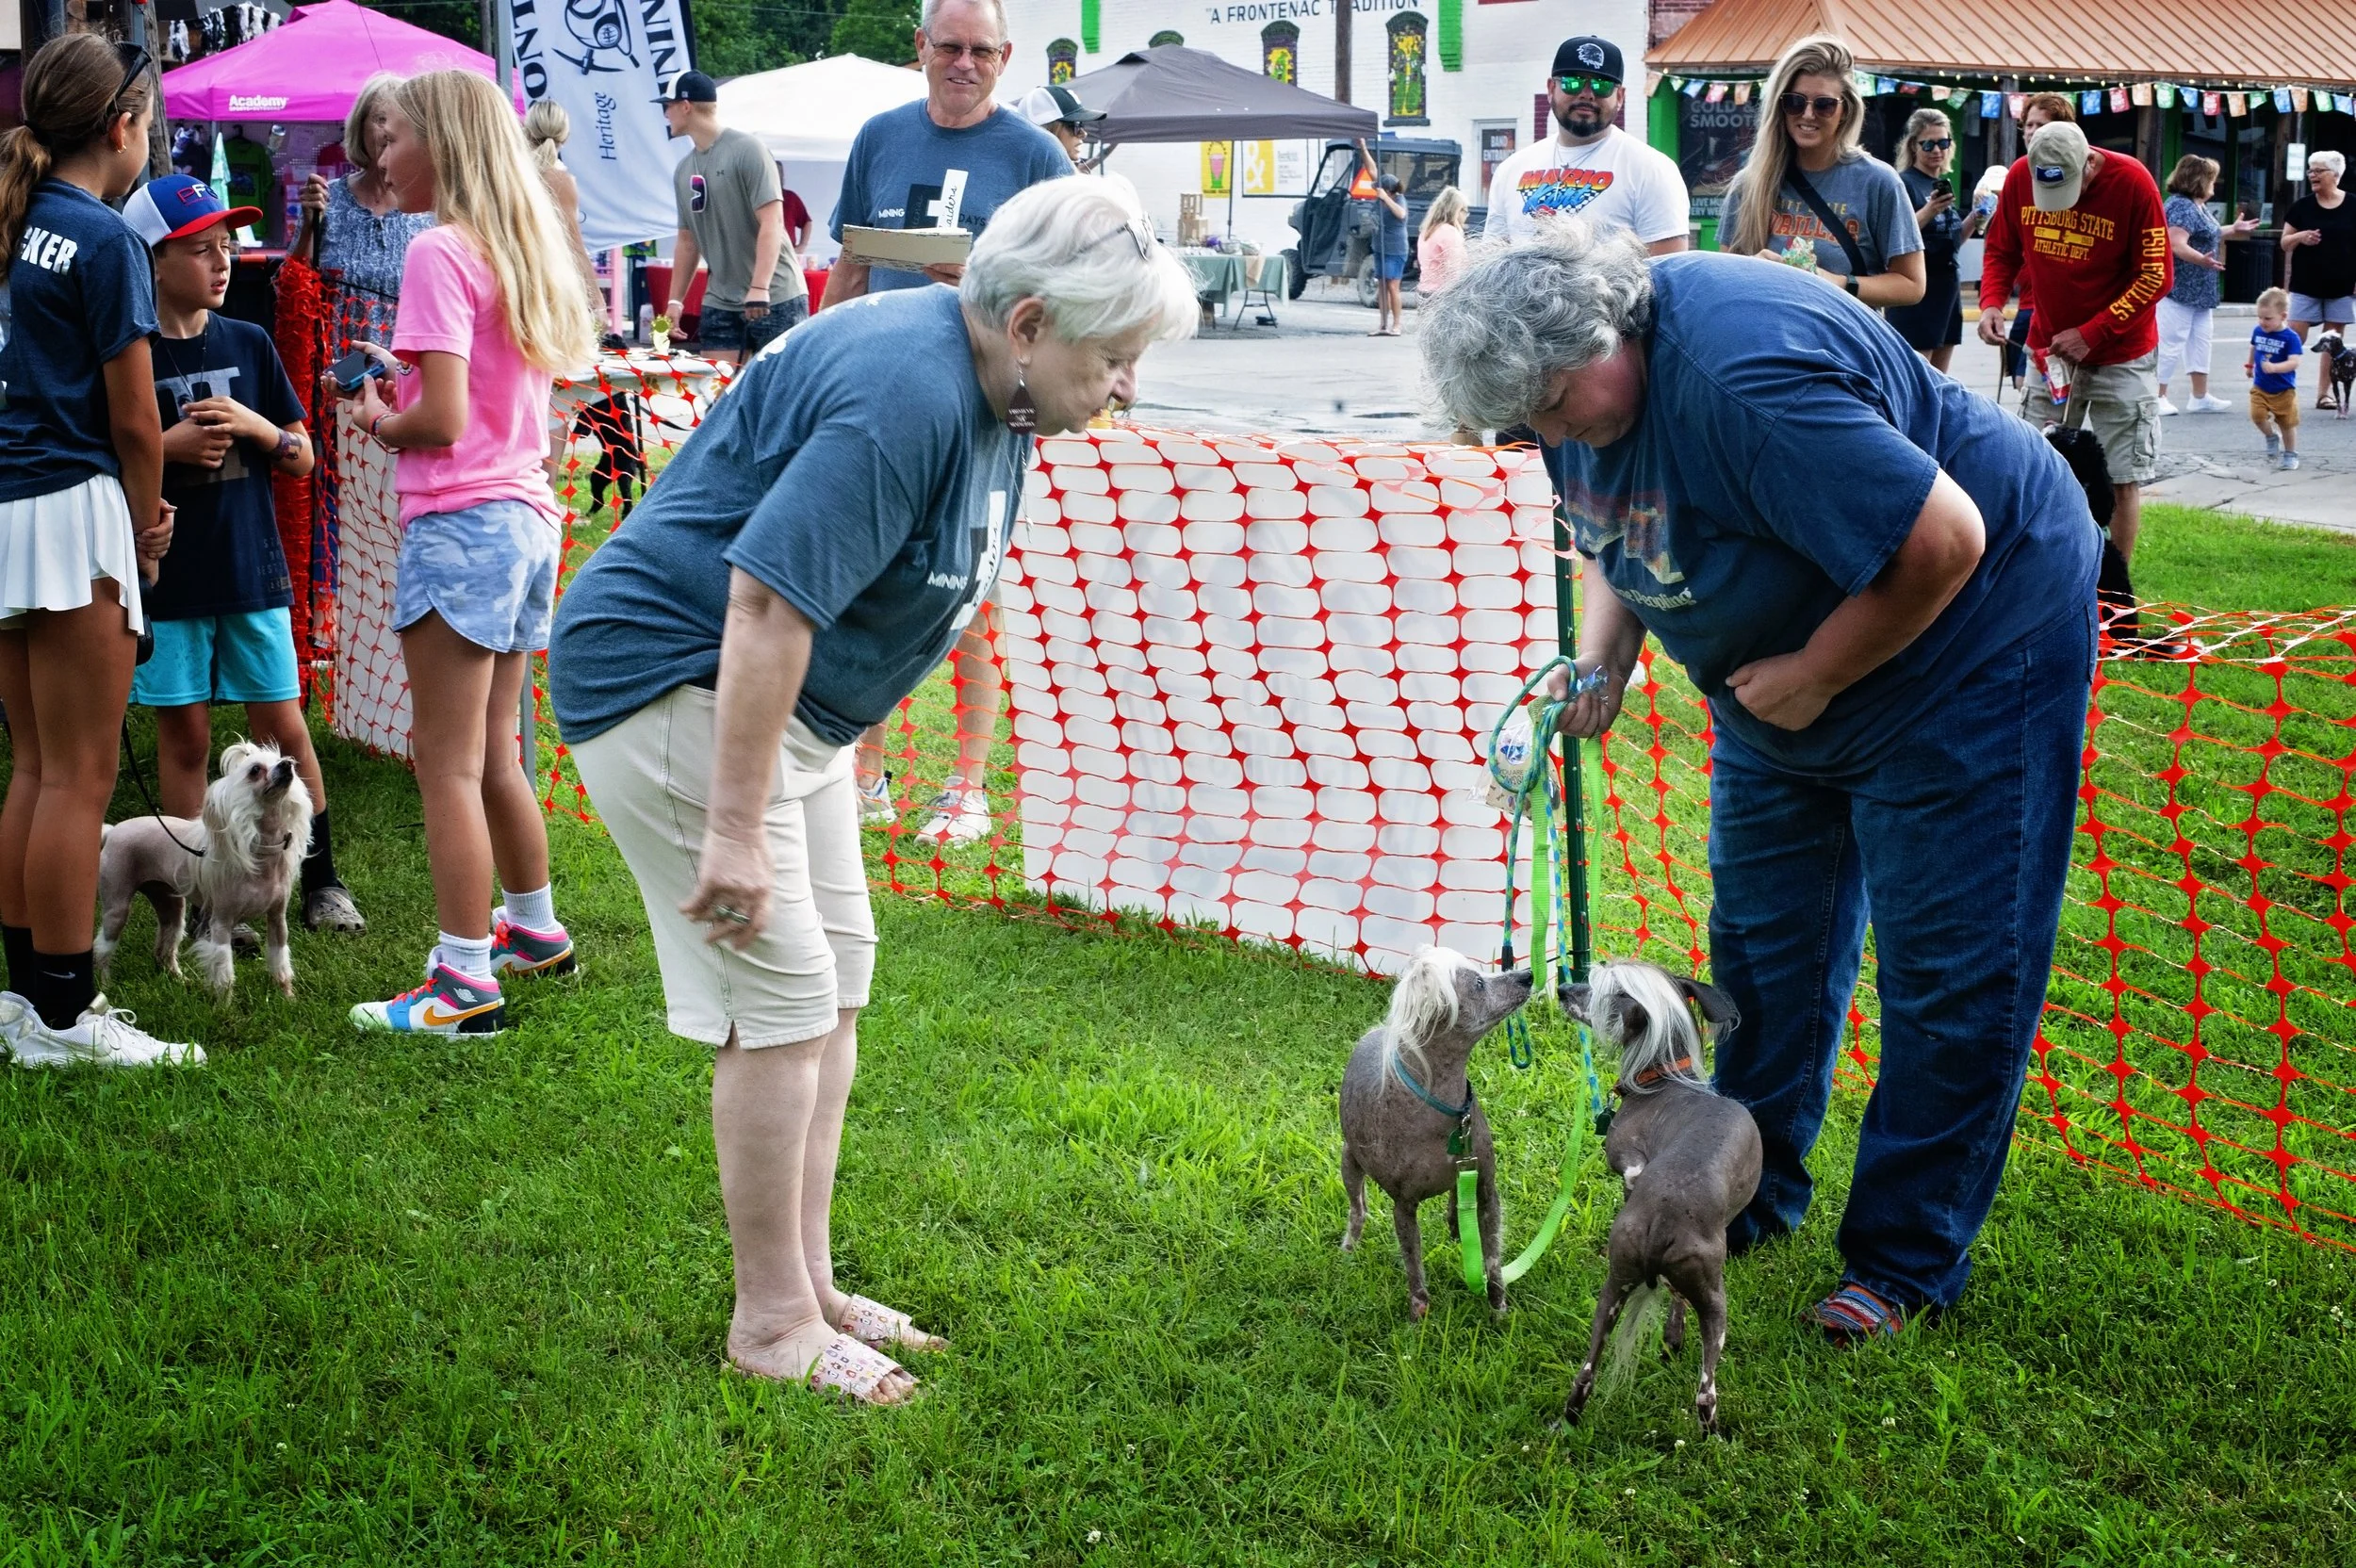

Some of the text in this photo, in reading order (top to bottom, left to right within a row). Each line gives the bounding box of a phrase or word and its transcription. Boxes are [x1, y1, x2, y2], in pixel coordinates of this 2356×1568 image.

[1227, 0, 1320, 23] FRONTENAC
[1328, 0, 1418, 14] TADITION
[229, 94, 288, 109] Academy
[1690, 99, 1737, 114] COLD
[596, 92, 617, 160] Heritage
[1690, 113, 1759, 128] SMOOT
[1491, 135, 1509, 148] BAND
[1482, 149, 1515, 162] ENTRAN
[1516, 168, 1615, 192] MARIO
[878, 207, 906, 220] MINING
[958, 213, 988, 227] DAYS
[2021, 205, 2115, 241] PITTSBURG STATE
[2034, 238, 2070, 256] ATHLETIC
[2070, 245, 2090, 261] DEPT.
[2141, 226, 2167, 257] PSU
[2109, 262, 2166, 321] GORILLAS
[1629, 586, 1697, 612] Peopling
